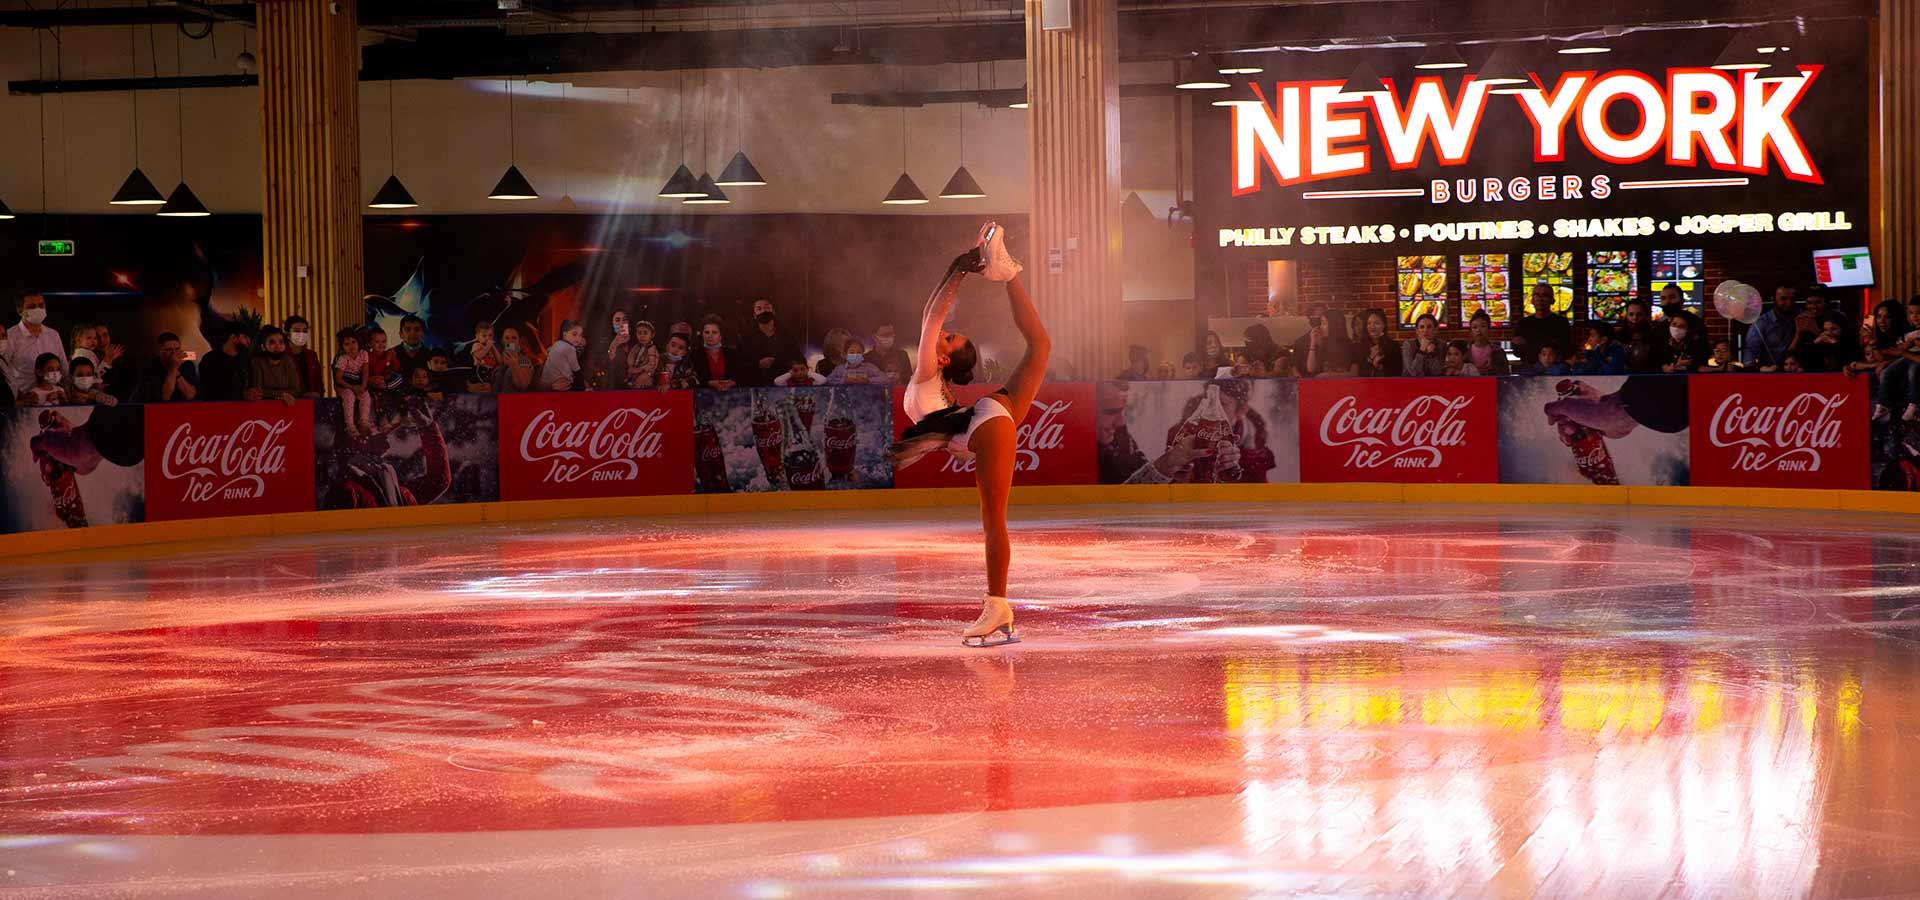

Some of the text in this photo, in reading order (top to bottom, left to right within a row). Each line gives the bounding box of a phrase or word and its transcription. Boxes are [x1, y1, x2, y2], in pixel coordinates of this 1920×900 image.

[1230, 64, 1824, 197] NEW YORK
[1430, 174, 1612, 204] BURGERS
[1218, 211, 1852, 247] PHILLY STEAKS POUTINES SHAKES JOSPER GRILL
[519, 407, 672, 462] Coca-Cola
[1319, 395, 1475, 446] Coca-Cola
[1709, 392, 1850, 448] Coca-Cola
[162, 419, 293, 480] Coca-Cola
[1394, 457, 1428, 468] RINK
[1777, 459, 1808, 471] RINK
[223, 487, 252, 500] RINK
[591, 470, 625, 482] RINK
